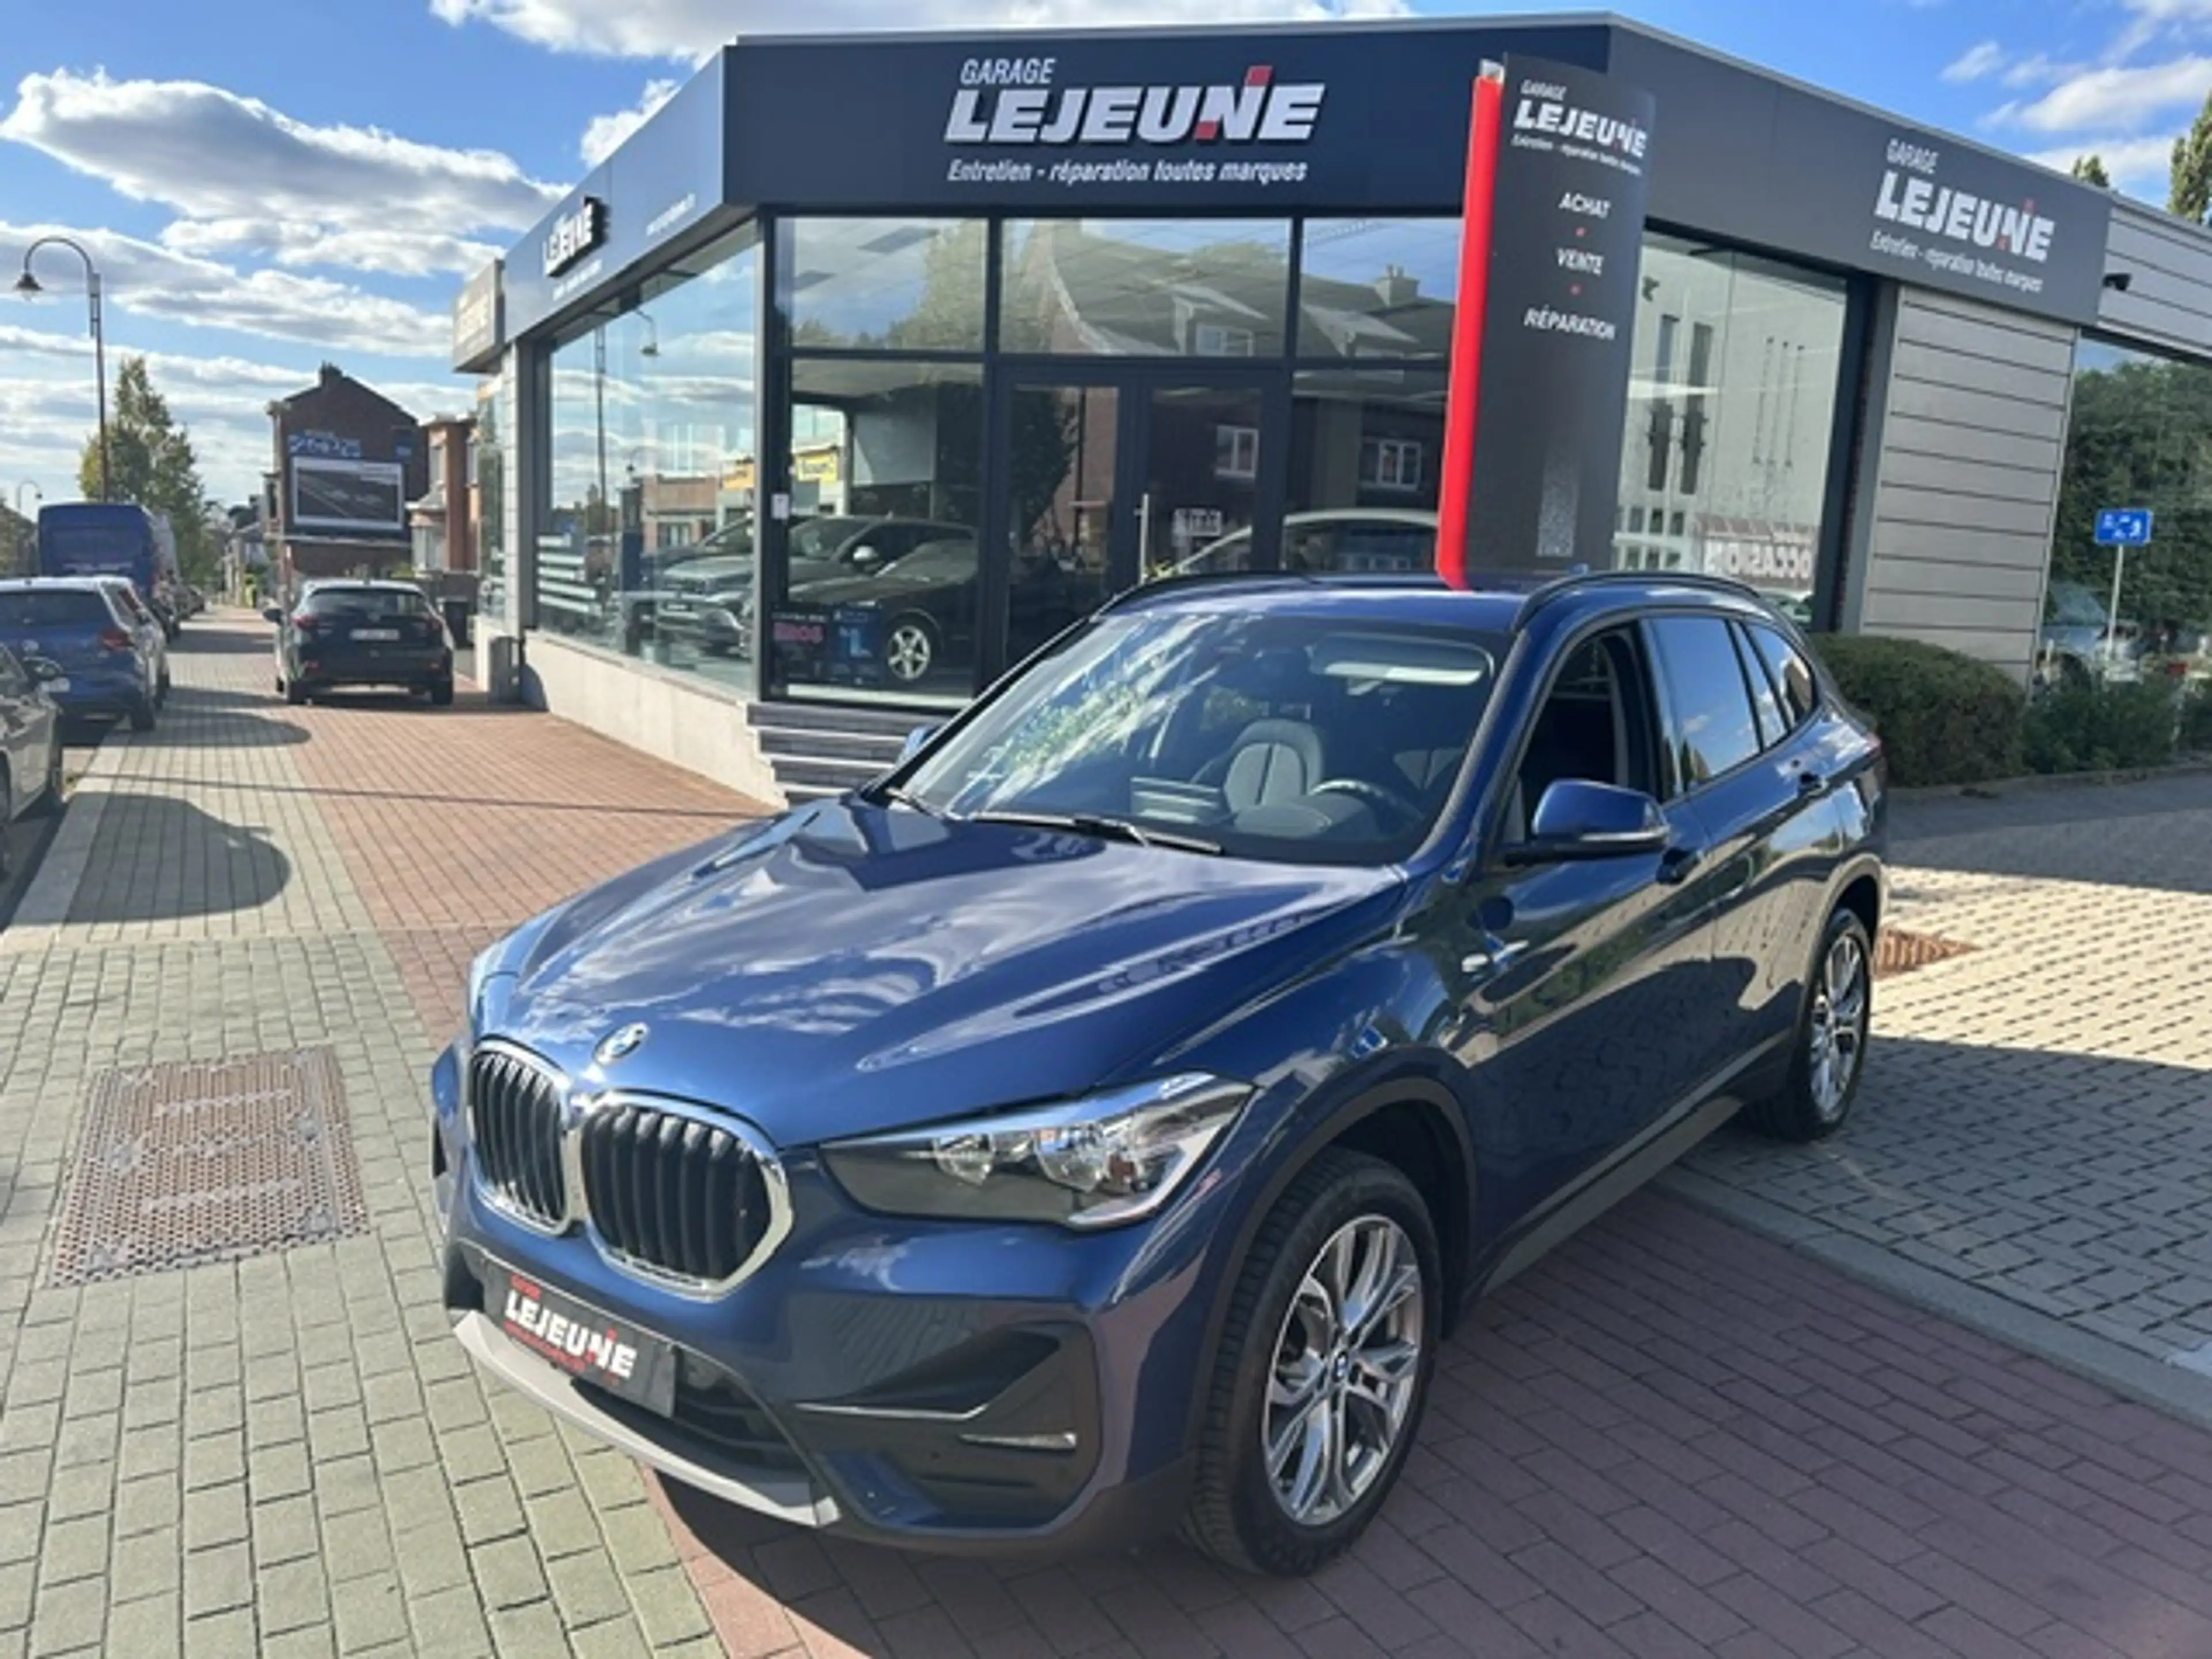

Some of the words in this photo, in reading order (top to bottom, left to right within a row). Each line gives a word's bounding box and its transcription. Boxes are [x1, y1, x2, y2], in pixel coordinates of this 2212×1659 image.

[961, 58, 1056, 84] GARAGE
[945, 66, 1325, 143] LEJEUNE
[1513, 100, 1647, 159] LEJEUNE
[948, 159, 1032, 181] Entretien
[1049, 159, 1150, 186] réparation
[1154, 159, 1214, 181] toutes
[1218, 162, 1307, 186] marques
[1558, 192, 1611, 219] ACHAT
[1874, 169, 2056, 263] LEJEUNE
[1558, 248, 1604, 276] VENTE
[1524, 304, 1615, 340] RÉPARATION
[505, 1289, 638, 1380] LEJEUNE
